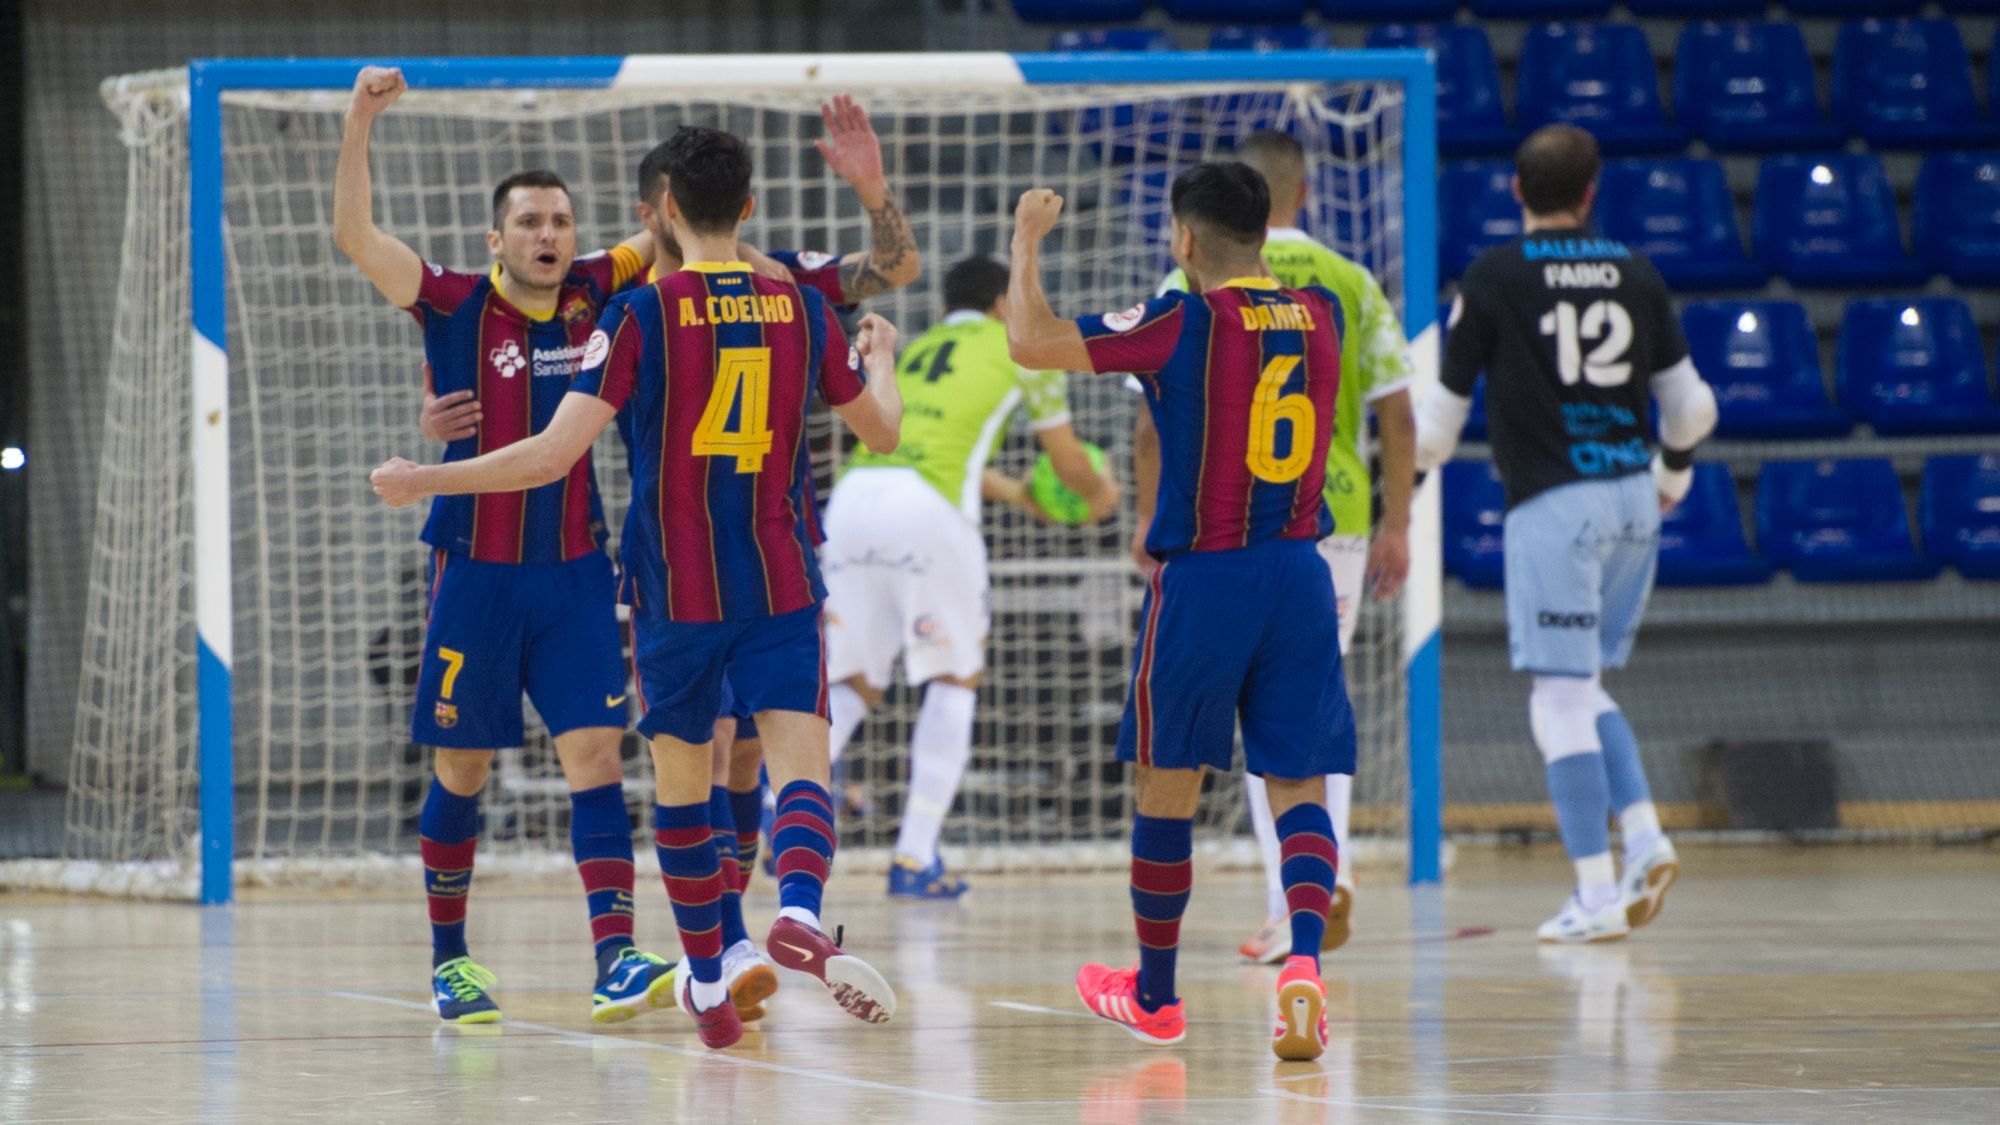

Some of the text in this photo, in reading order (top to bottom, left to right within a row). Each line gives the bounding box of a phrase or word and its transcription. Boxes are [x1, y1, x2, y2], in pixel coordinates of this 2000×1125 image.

[1544, 262, 1621, 289] FABIO
[1239, 303, 1316, 331] DANIEL
[1539, 300, 1634, 387] 12
[899, 340, 956, 383] 4
[691, 347, 773, 473] 4
[1245, 354, 1316, 483] 6
[438, 646, 464, 699] 7
